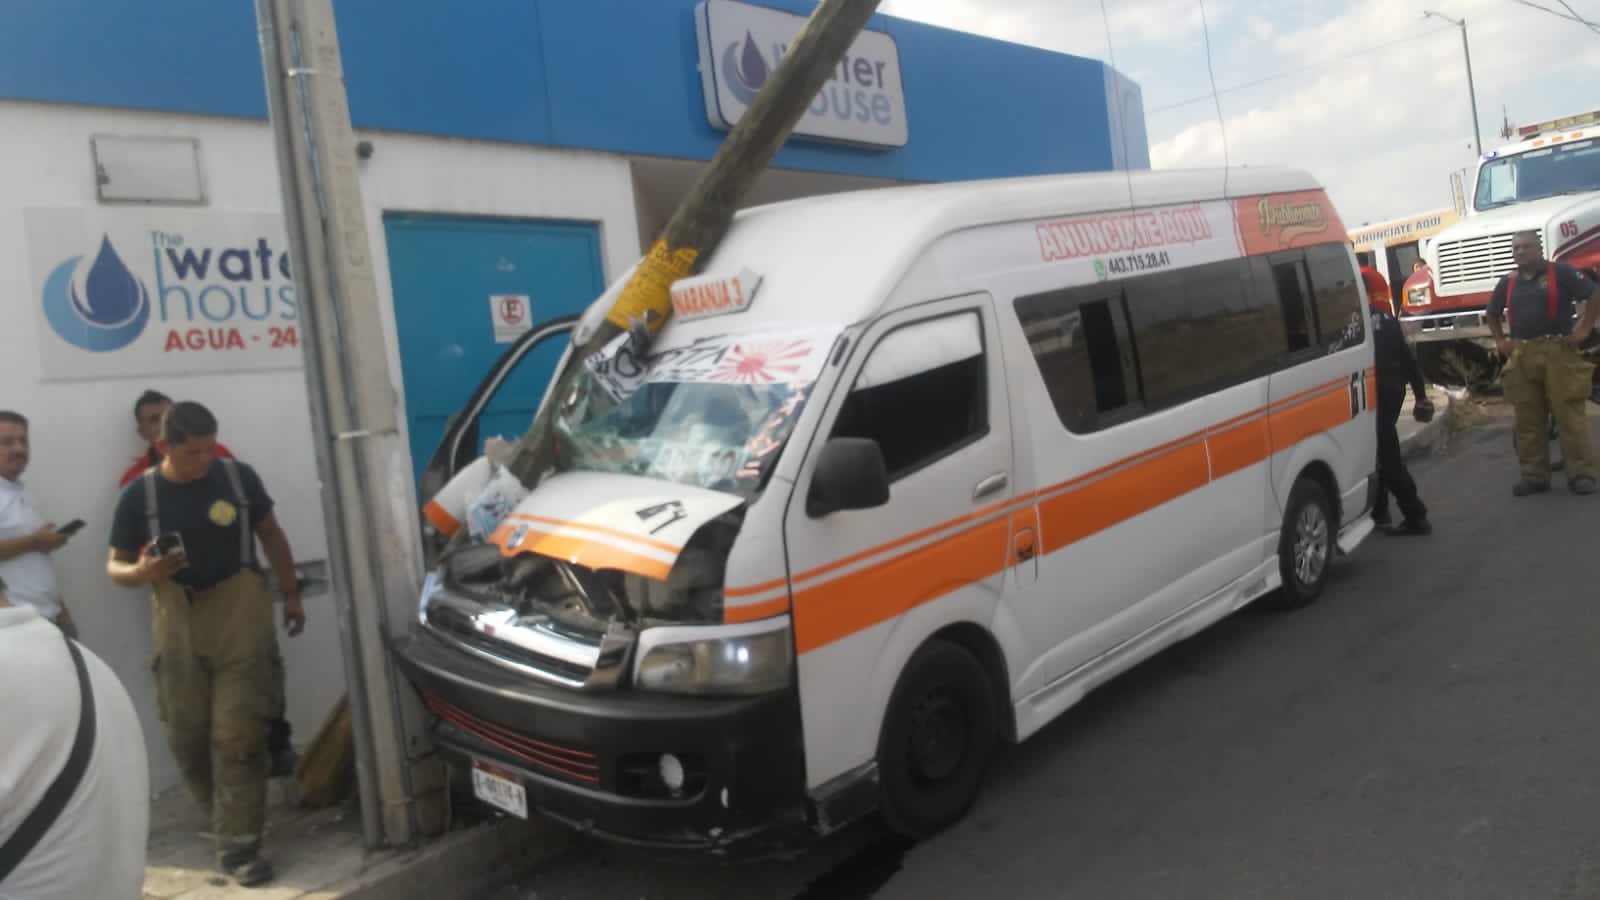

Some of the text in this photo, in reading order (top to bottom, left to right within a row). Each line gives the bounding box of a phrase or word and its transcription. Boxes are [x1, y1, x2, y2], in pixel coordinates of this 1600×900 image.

[151, 231, 185, 246] The
[1035, 211, 1163, 262] ANUNCIATE
[1355, 223, 1413, 245] ANUNCIATE
[1559, 219, 1578, 239] 05
[165, 237, 292, 282] wat
[153, 248, 298, 322] hous
[672, 279, 731, 316] NARANJA
[164, 327, 246, 352] AGUA
[268, 325, 299, 350] 24
